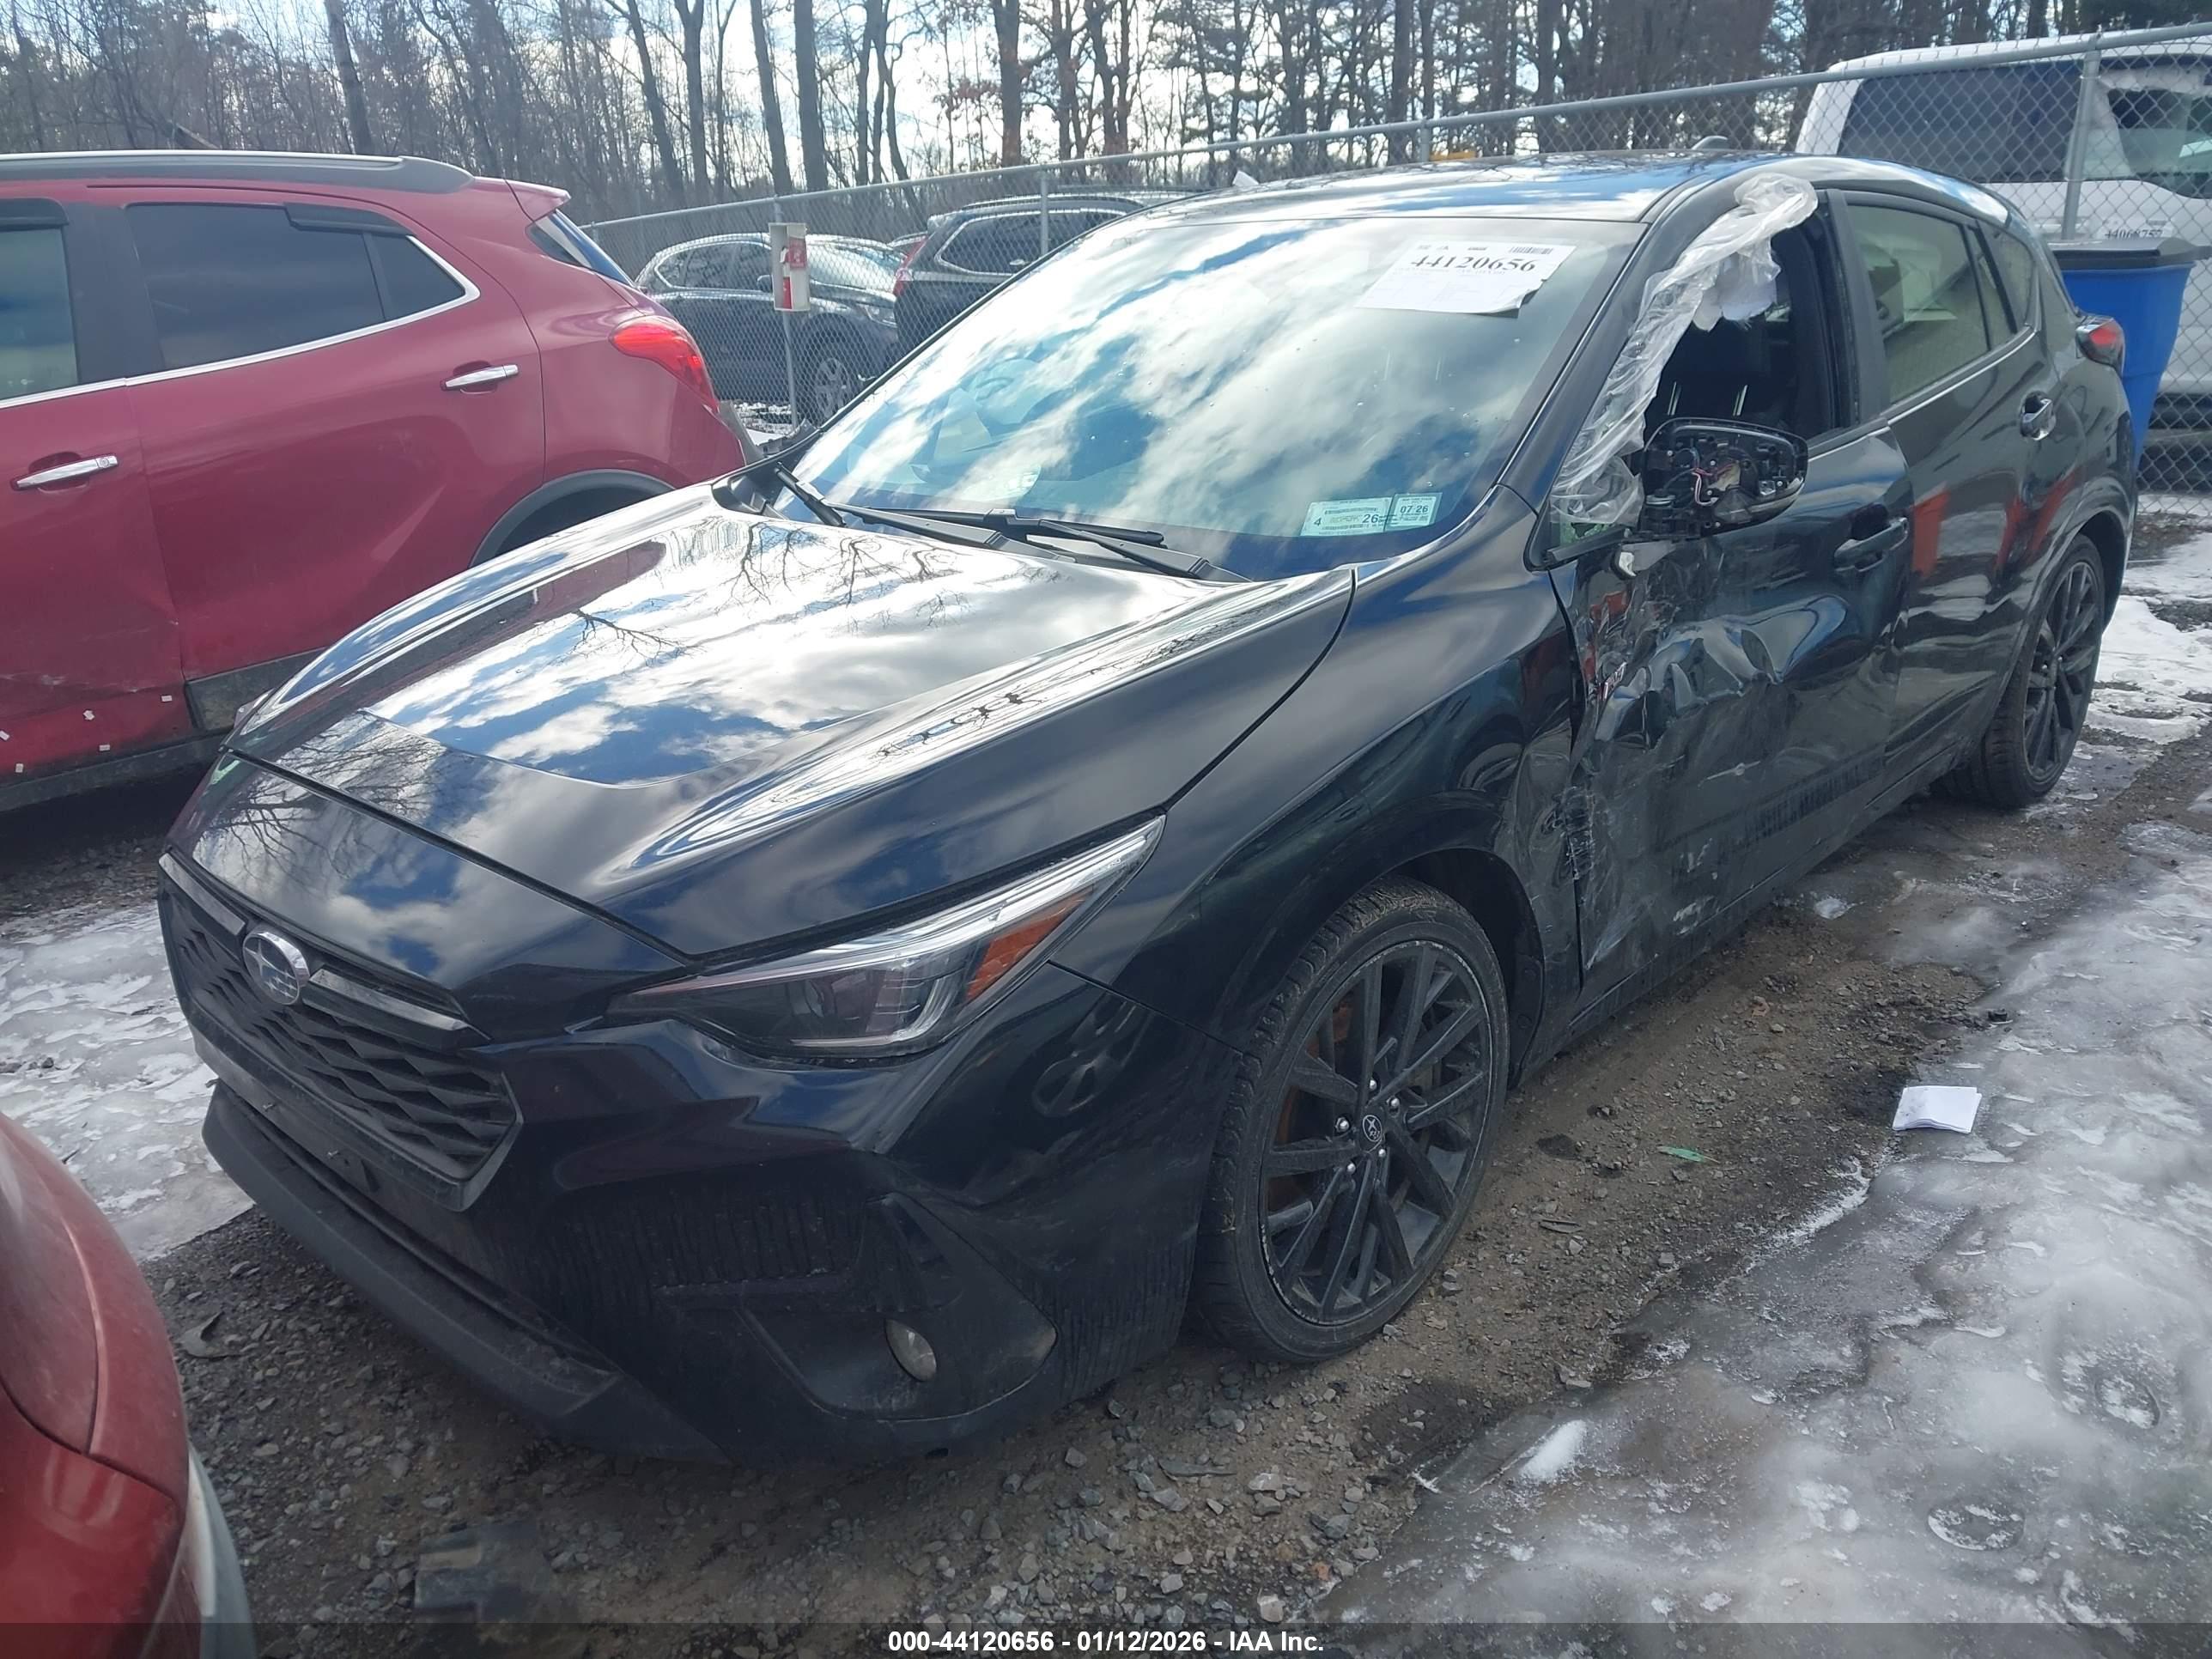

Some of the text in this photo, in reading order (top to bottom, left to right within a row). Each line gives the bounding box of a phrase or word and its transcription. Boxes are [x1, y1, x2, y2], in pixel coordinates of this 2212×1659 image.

[1410, 255, 1538, 272] 44120656
[1313, 517, 1322, 526] 4
[1362, 514, 1379, 524] 26
